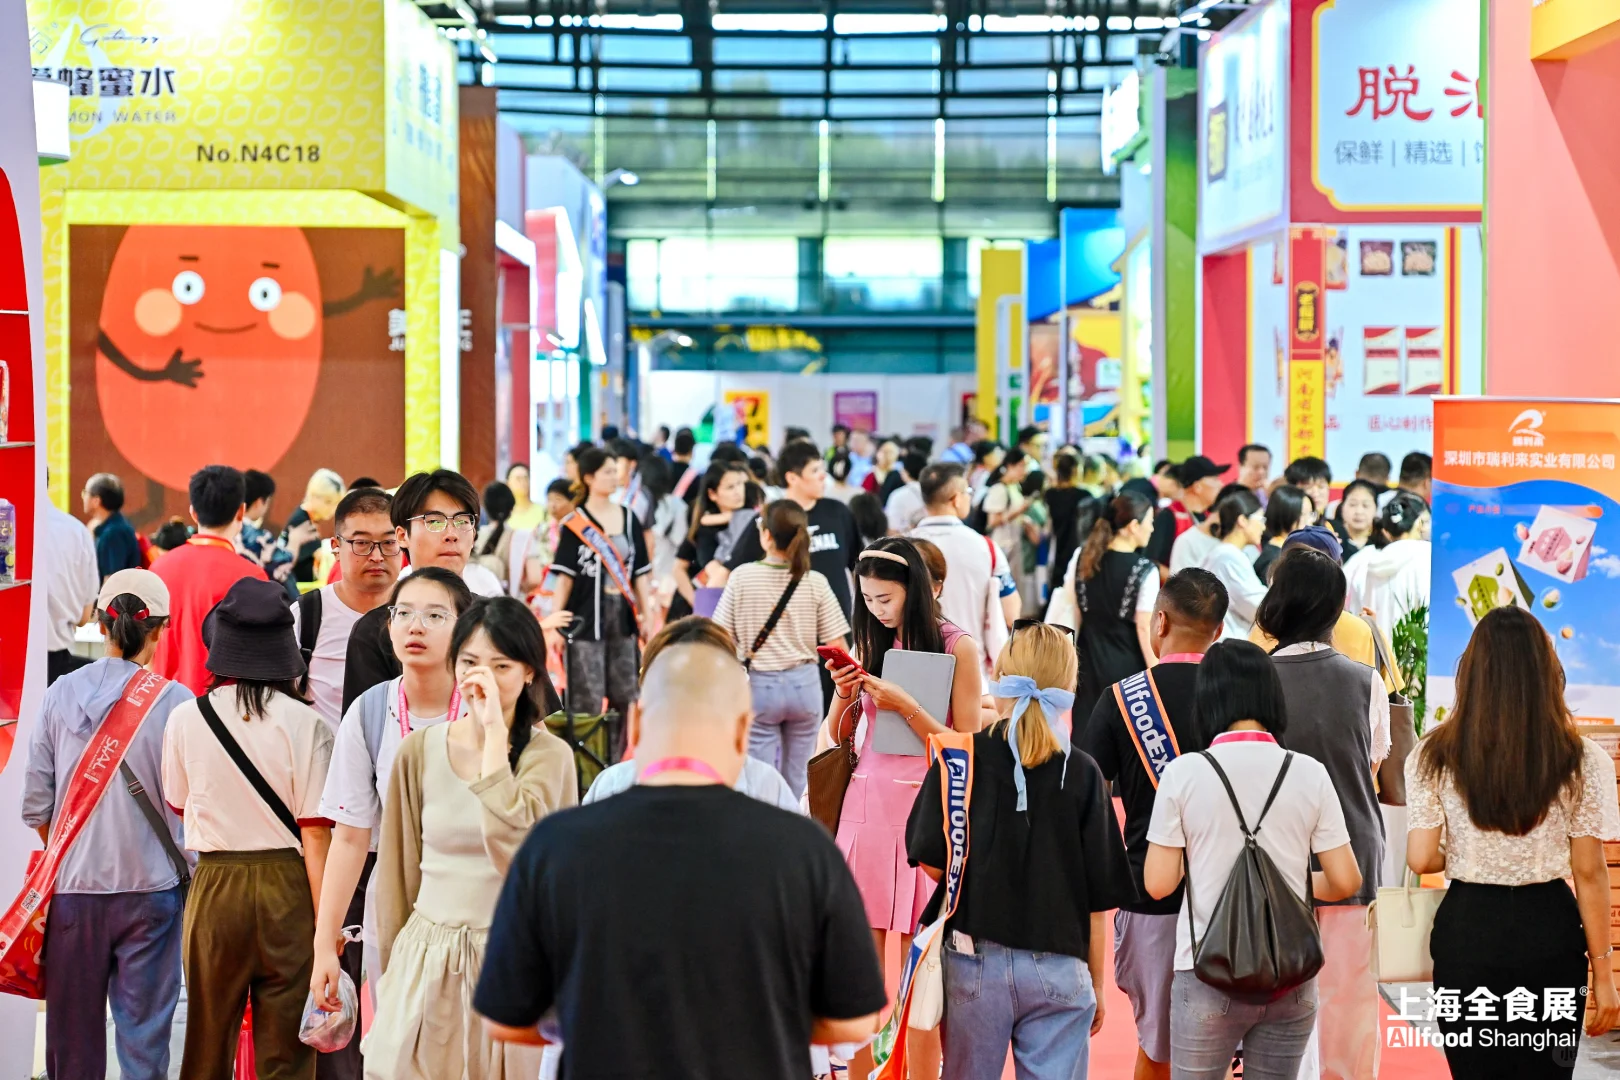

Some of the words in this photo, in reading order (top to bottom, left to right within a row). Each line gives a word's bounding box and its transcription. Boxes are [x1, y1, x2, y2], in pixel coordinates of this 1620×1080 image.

[113, 110, 177, 123] WATER
[197, 144, 320, 163] No.N4C18
[1334, 140, 1384, 165] 保鲜
[1403, 140, 1453, 165] 精选
[1444, 450, 1615, 470] 深圳市瑞利来实业有限公司
